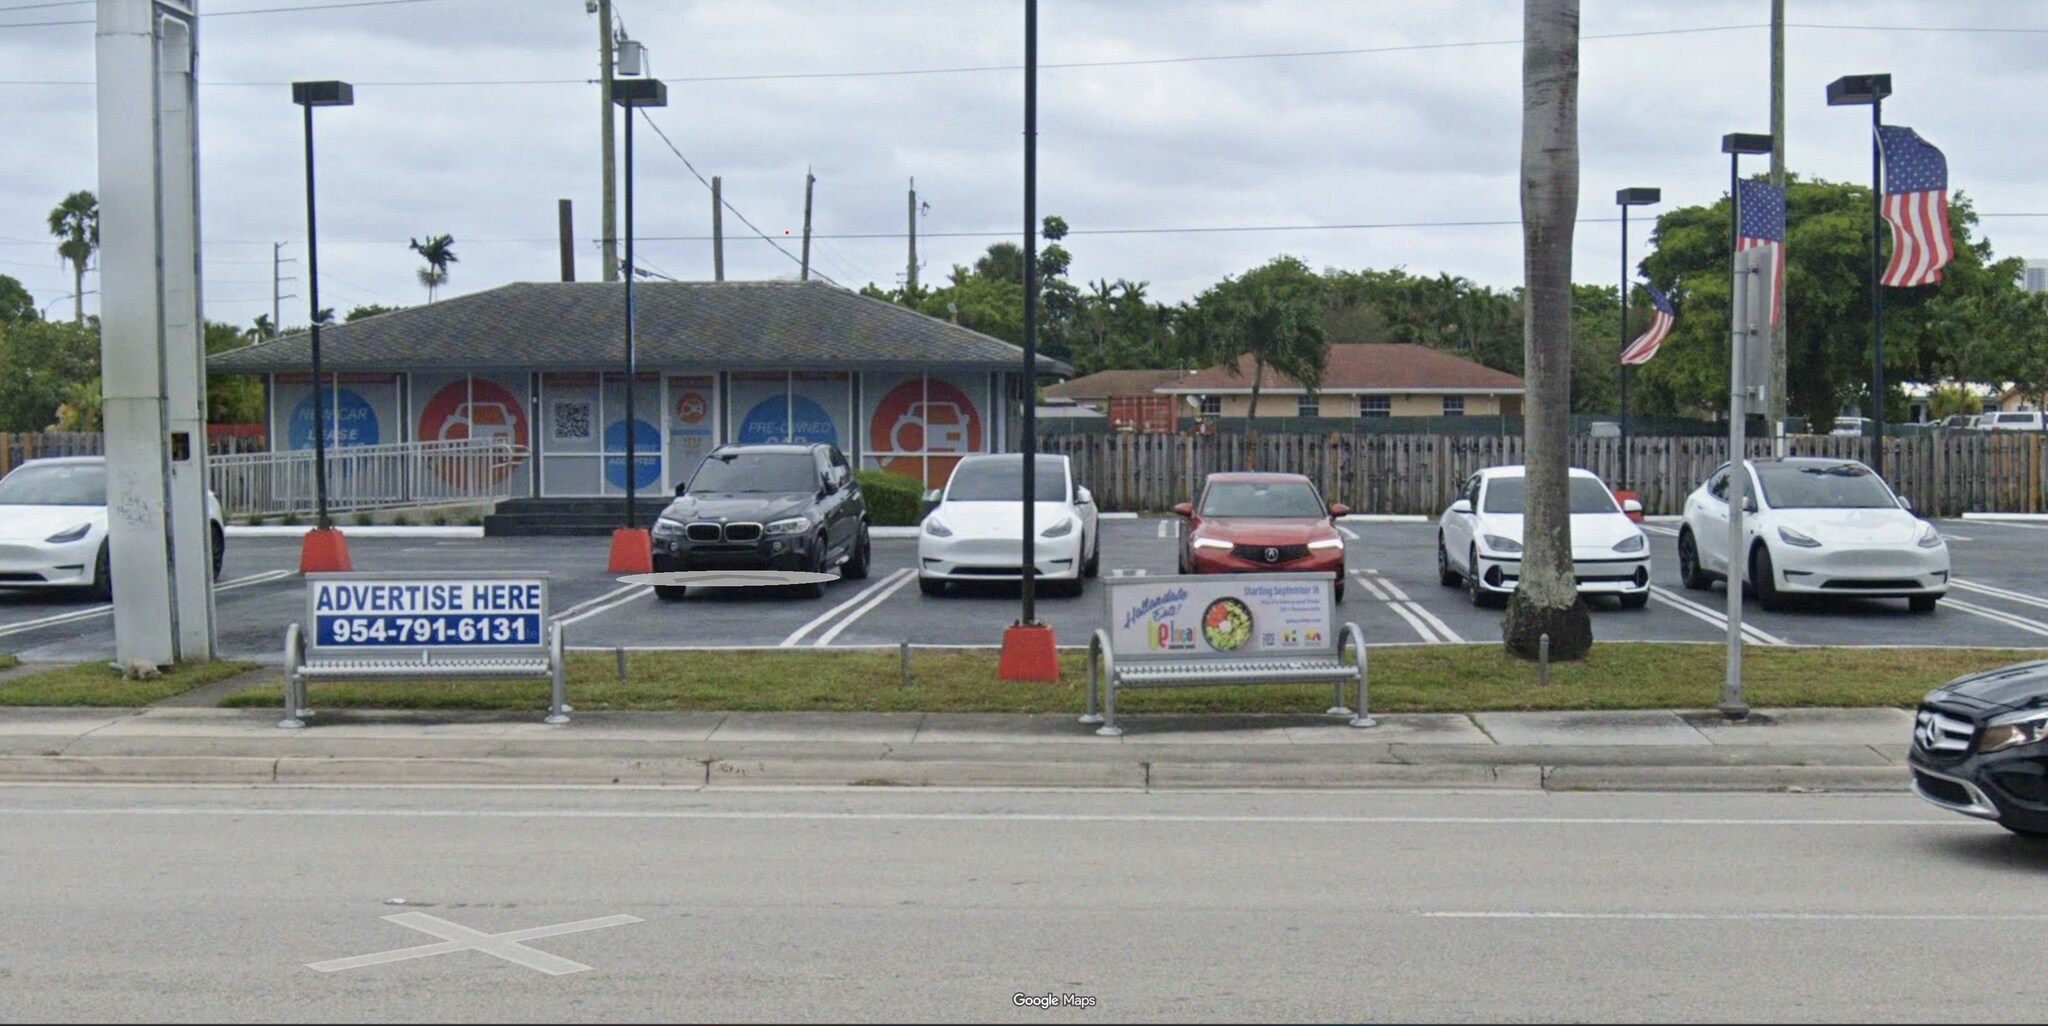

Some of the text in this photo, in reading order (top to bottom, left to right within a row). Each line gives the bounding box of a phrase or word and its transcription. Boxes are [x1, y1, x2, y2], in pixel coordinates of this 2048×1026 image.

[339, 407, 368, 420] CAR
[748, 421, 831, 433] PRE-OWNED
[307, 428, 359, 440] LASE
[607, 456, 657, 466] ACCPTED
[316, 585, 540, 611] ADVERTISE HERE
[1123, 587, 1188, 630] Hallandale
[332, 617, 525, 643] 954-791-6131
